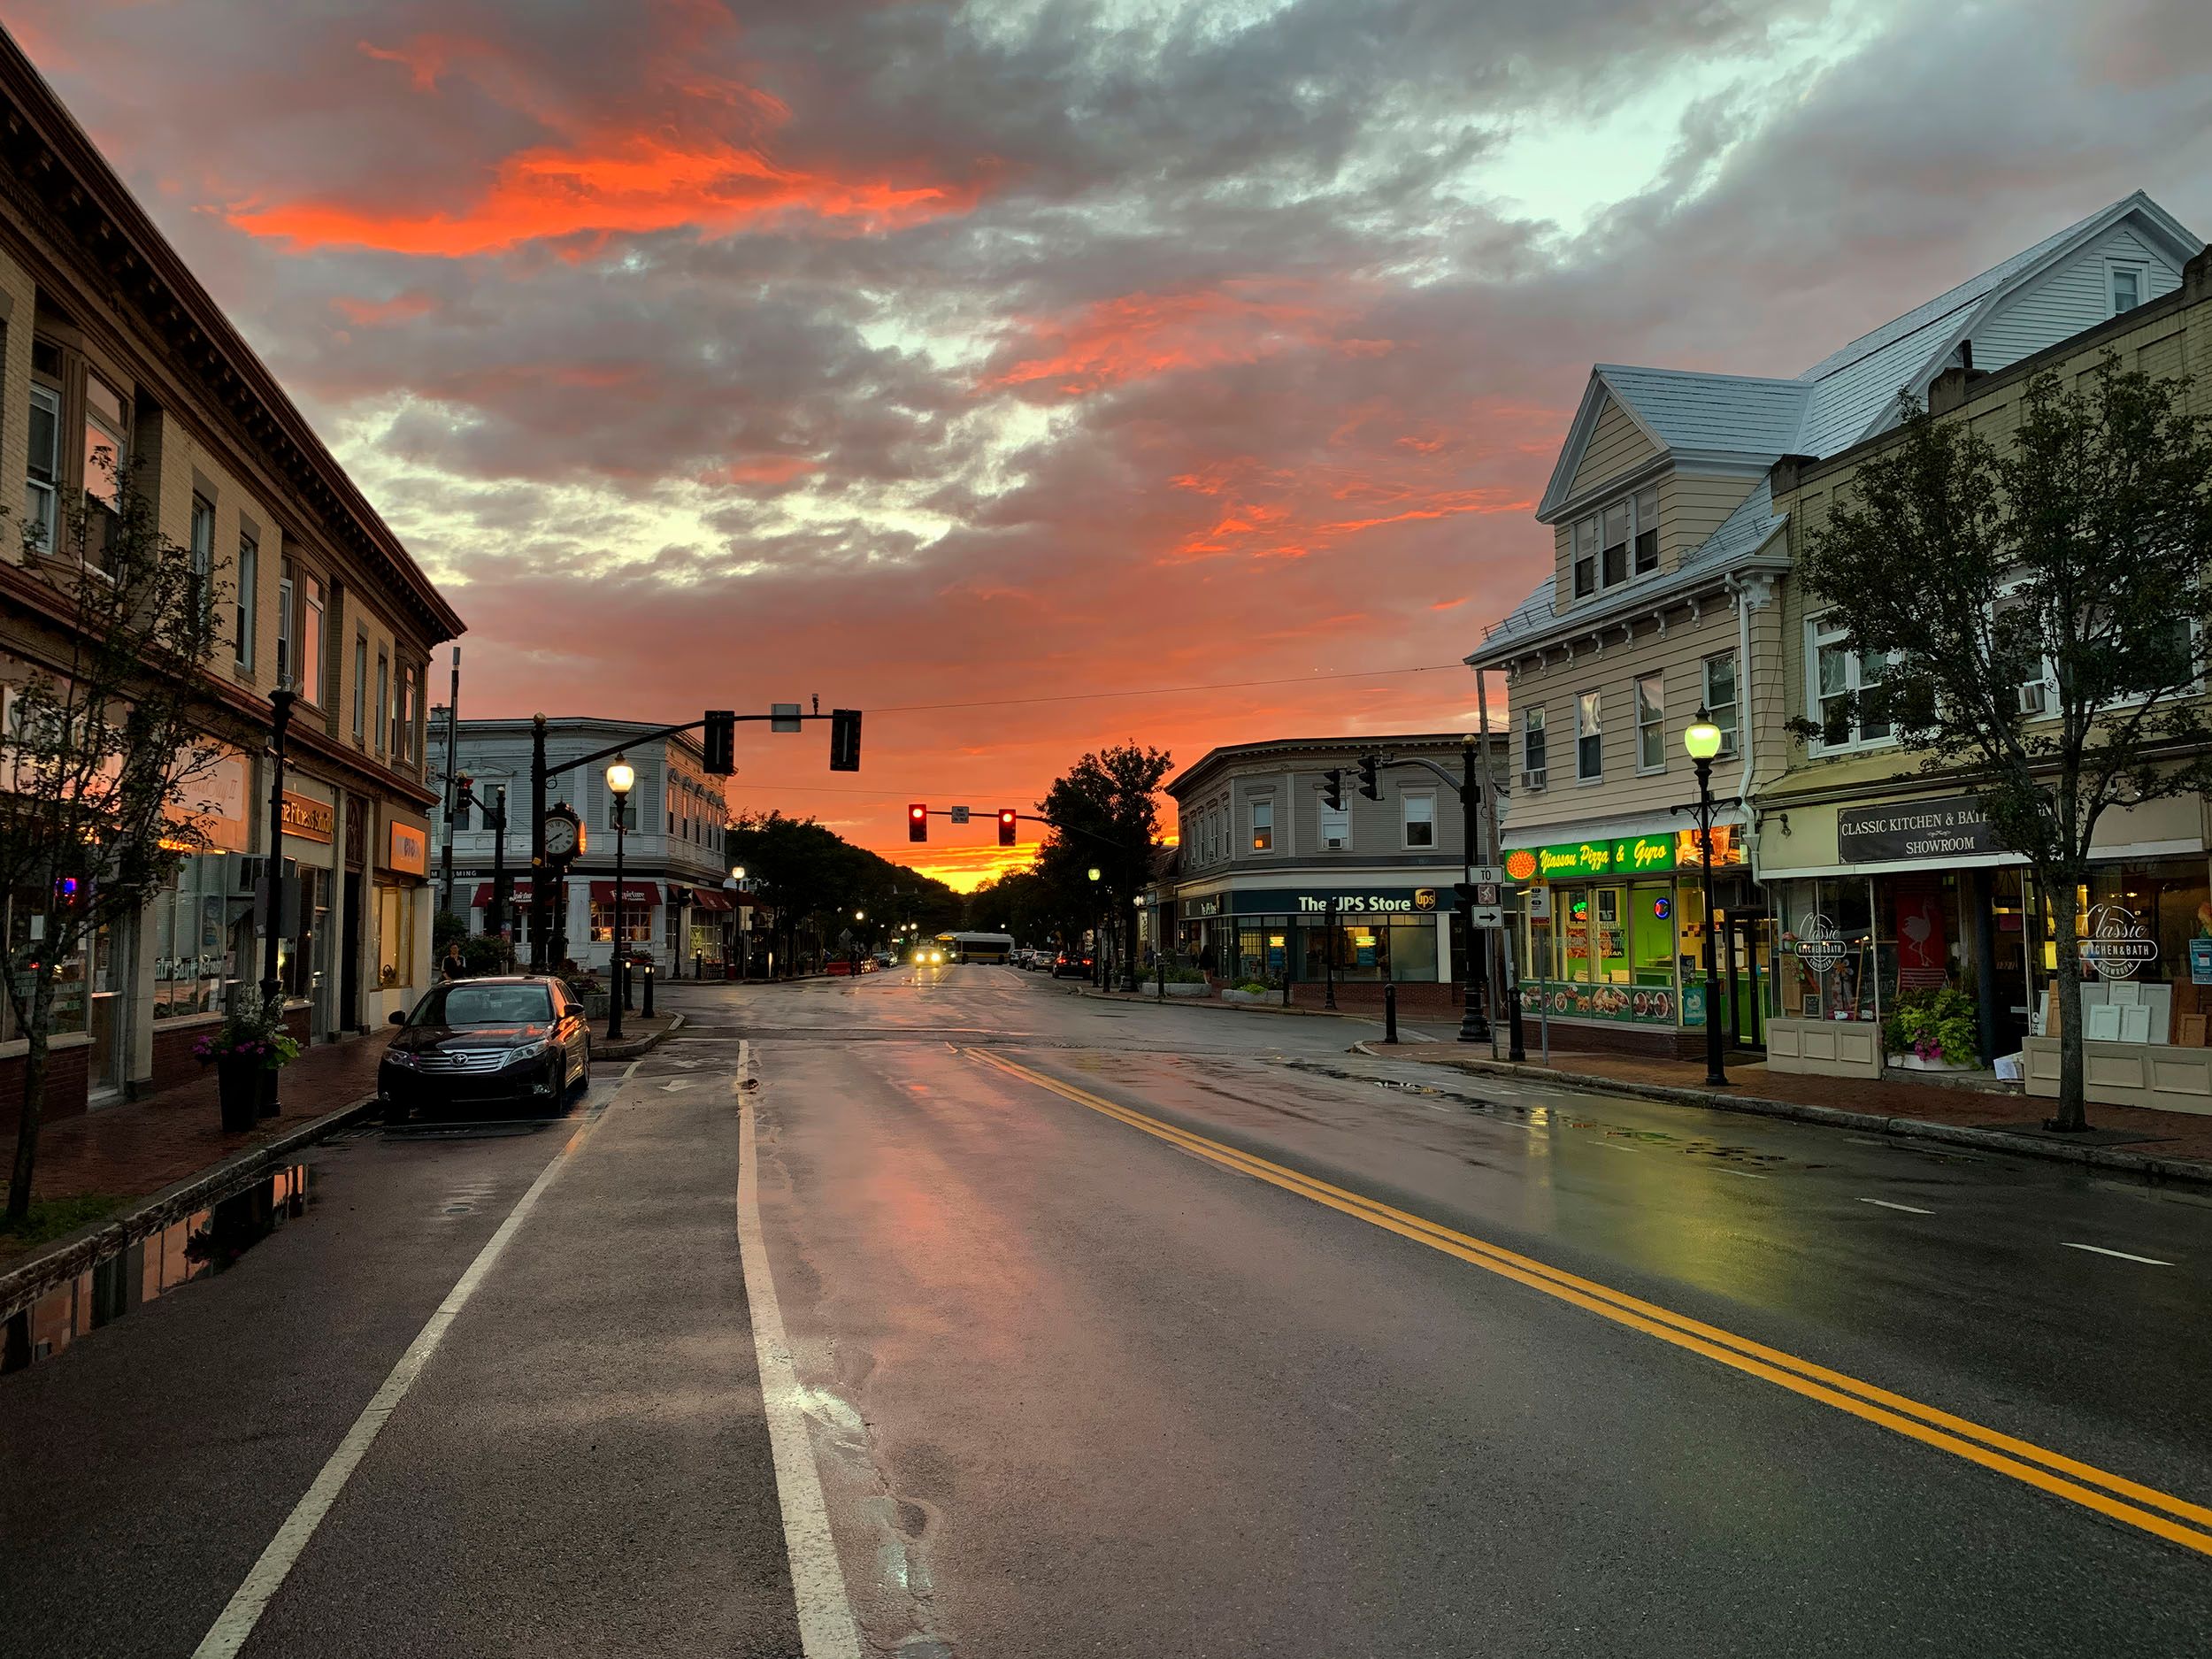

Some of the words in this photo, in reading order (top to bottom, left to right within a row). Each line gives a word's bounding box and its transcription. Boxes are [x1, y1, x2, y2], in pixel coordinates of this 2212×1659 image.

[1841, 819, 1887, 836] CLASSIC
[1889, 813, 1942, 832] KITCHEN
[1945, 811, 1955, 826] &
[1579, 845, 1609, 871] Pizza
[1616, 844, 1624, 863] &
[1634, 839, 1667, 868] Gyro
[1906, 836, 1976, 855] SHOWROOM
[1480, 870, 1492, 881] TO
[1298, 895, 1327, 911] The
[1368, 895, 1411, 911] Store
[1417, 894, 1434, 908] ups
[1800, 912, 1841, 941] Classic
[2081, 902, 2147, 939] Classic
[2098, 961, 2134, 976] SHOWROOM
